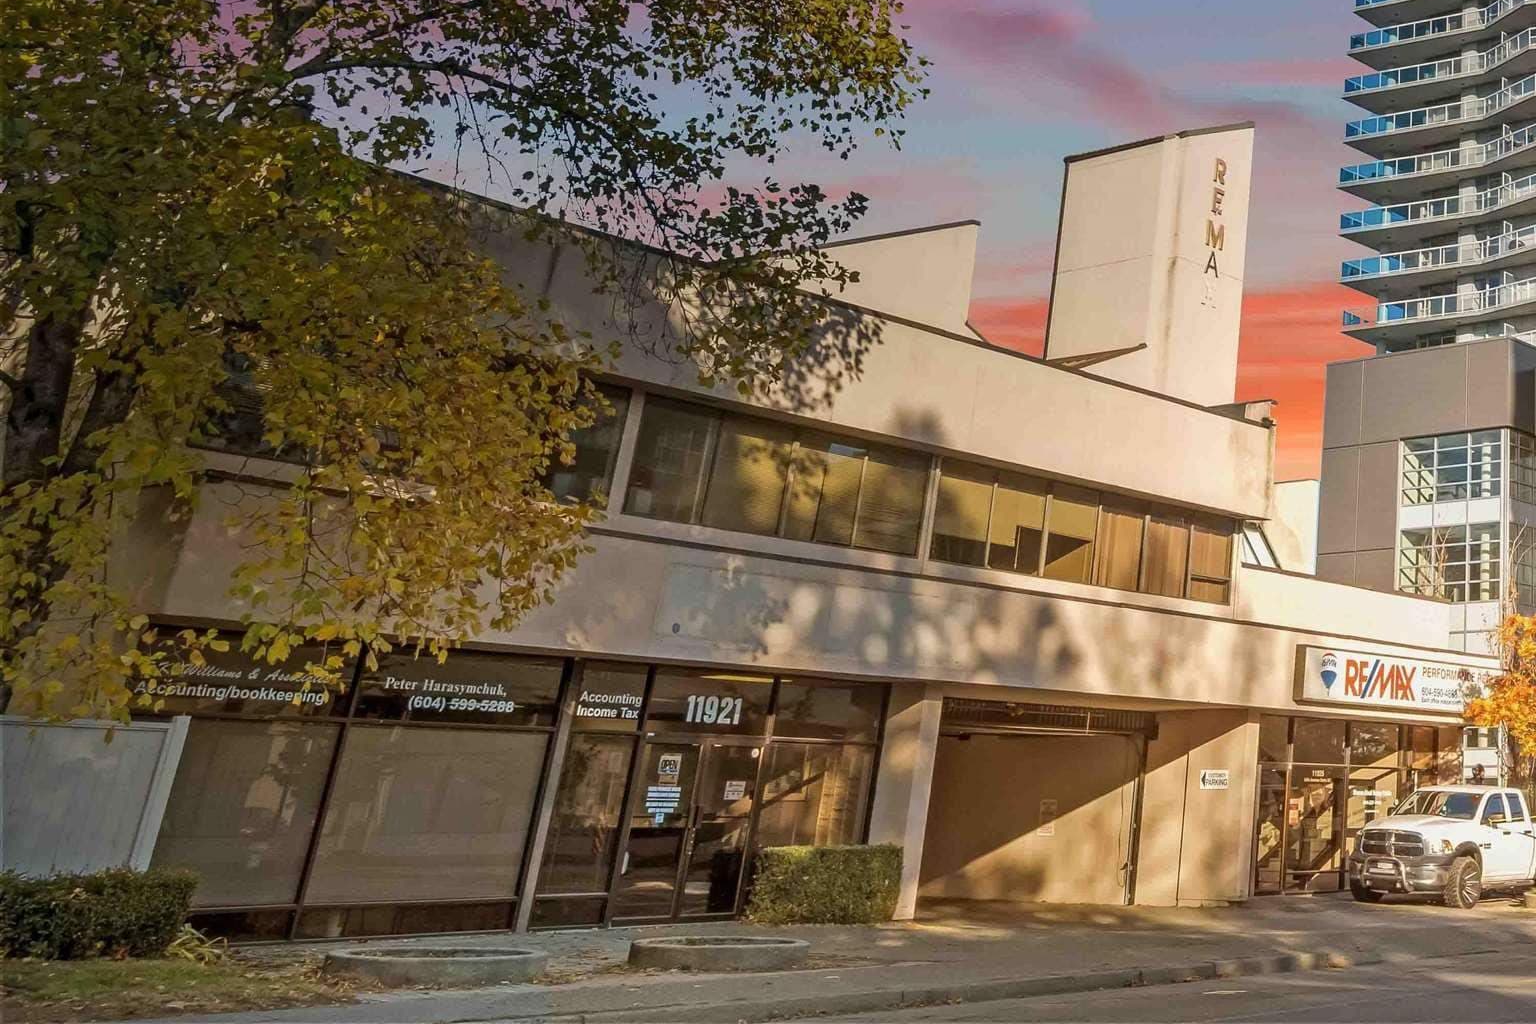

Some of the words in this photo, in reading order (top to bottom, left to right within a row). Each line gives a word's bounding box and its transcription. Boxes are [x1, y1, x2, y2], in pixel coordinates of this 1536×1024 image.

[1203, 158, 1228, 279] REMA
[247, 668, 259, 680] &
[1343, 659, 1416, 701] RE/MAX
[384, 676, 418, 691] Peter
[408, 695, 446, 713] (604)
[579, 690, 642, 708] Accounting
[576, 704, 617, 718] Income
[620, 707, 639, 719] Tax
[685, 694, 743, 725] 11921
